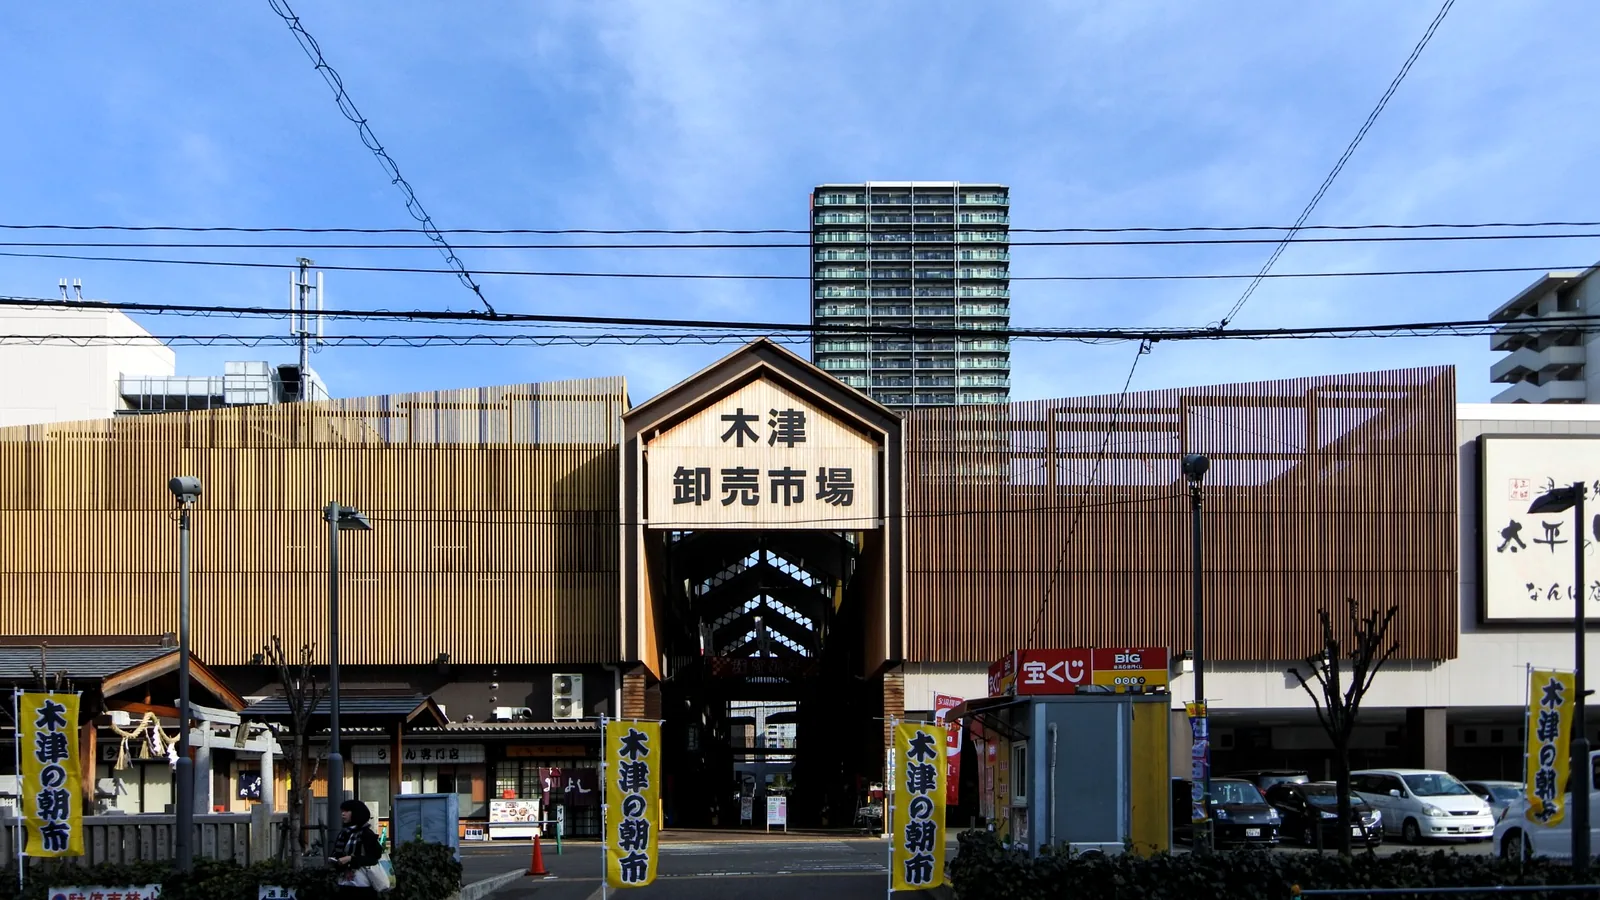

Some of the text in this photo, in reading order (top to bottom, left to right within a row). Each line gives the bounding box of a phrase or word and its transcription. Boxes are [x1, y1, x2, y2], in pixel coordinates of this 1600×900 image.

[720, 408, 807, 448] 木津
[672, 466, 855, 506] 卸売市場
[1023, 660, 1085, 685] 宝くじ
[377, 748, 460, 760] うん専門店
[36, 699, 71, 852] 木津の朝市
[618, 727, 650, 883] 木津の朝市
[905, 730, 937, 886] 木津の朝市
